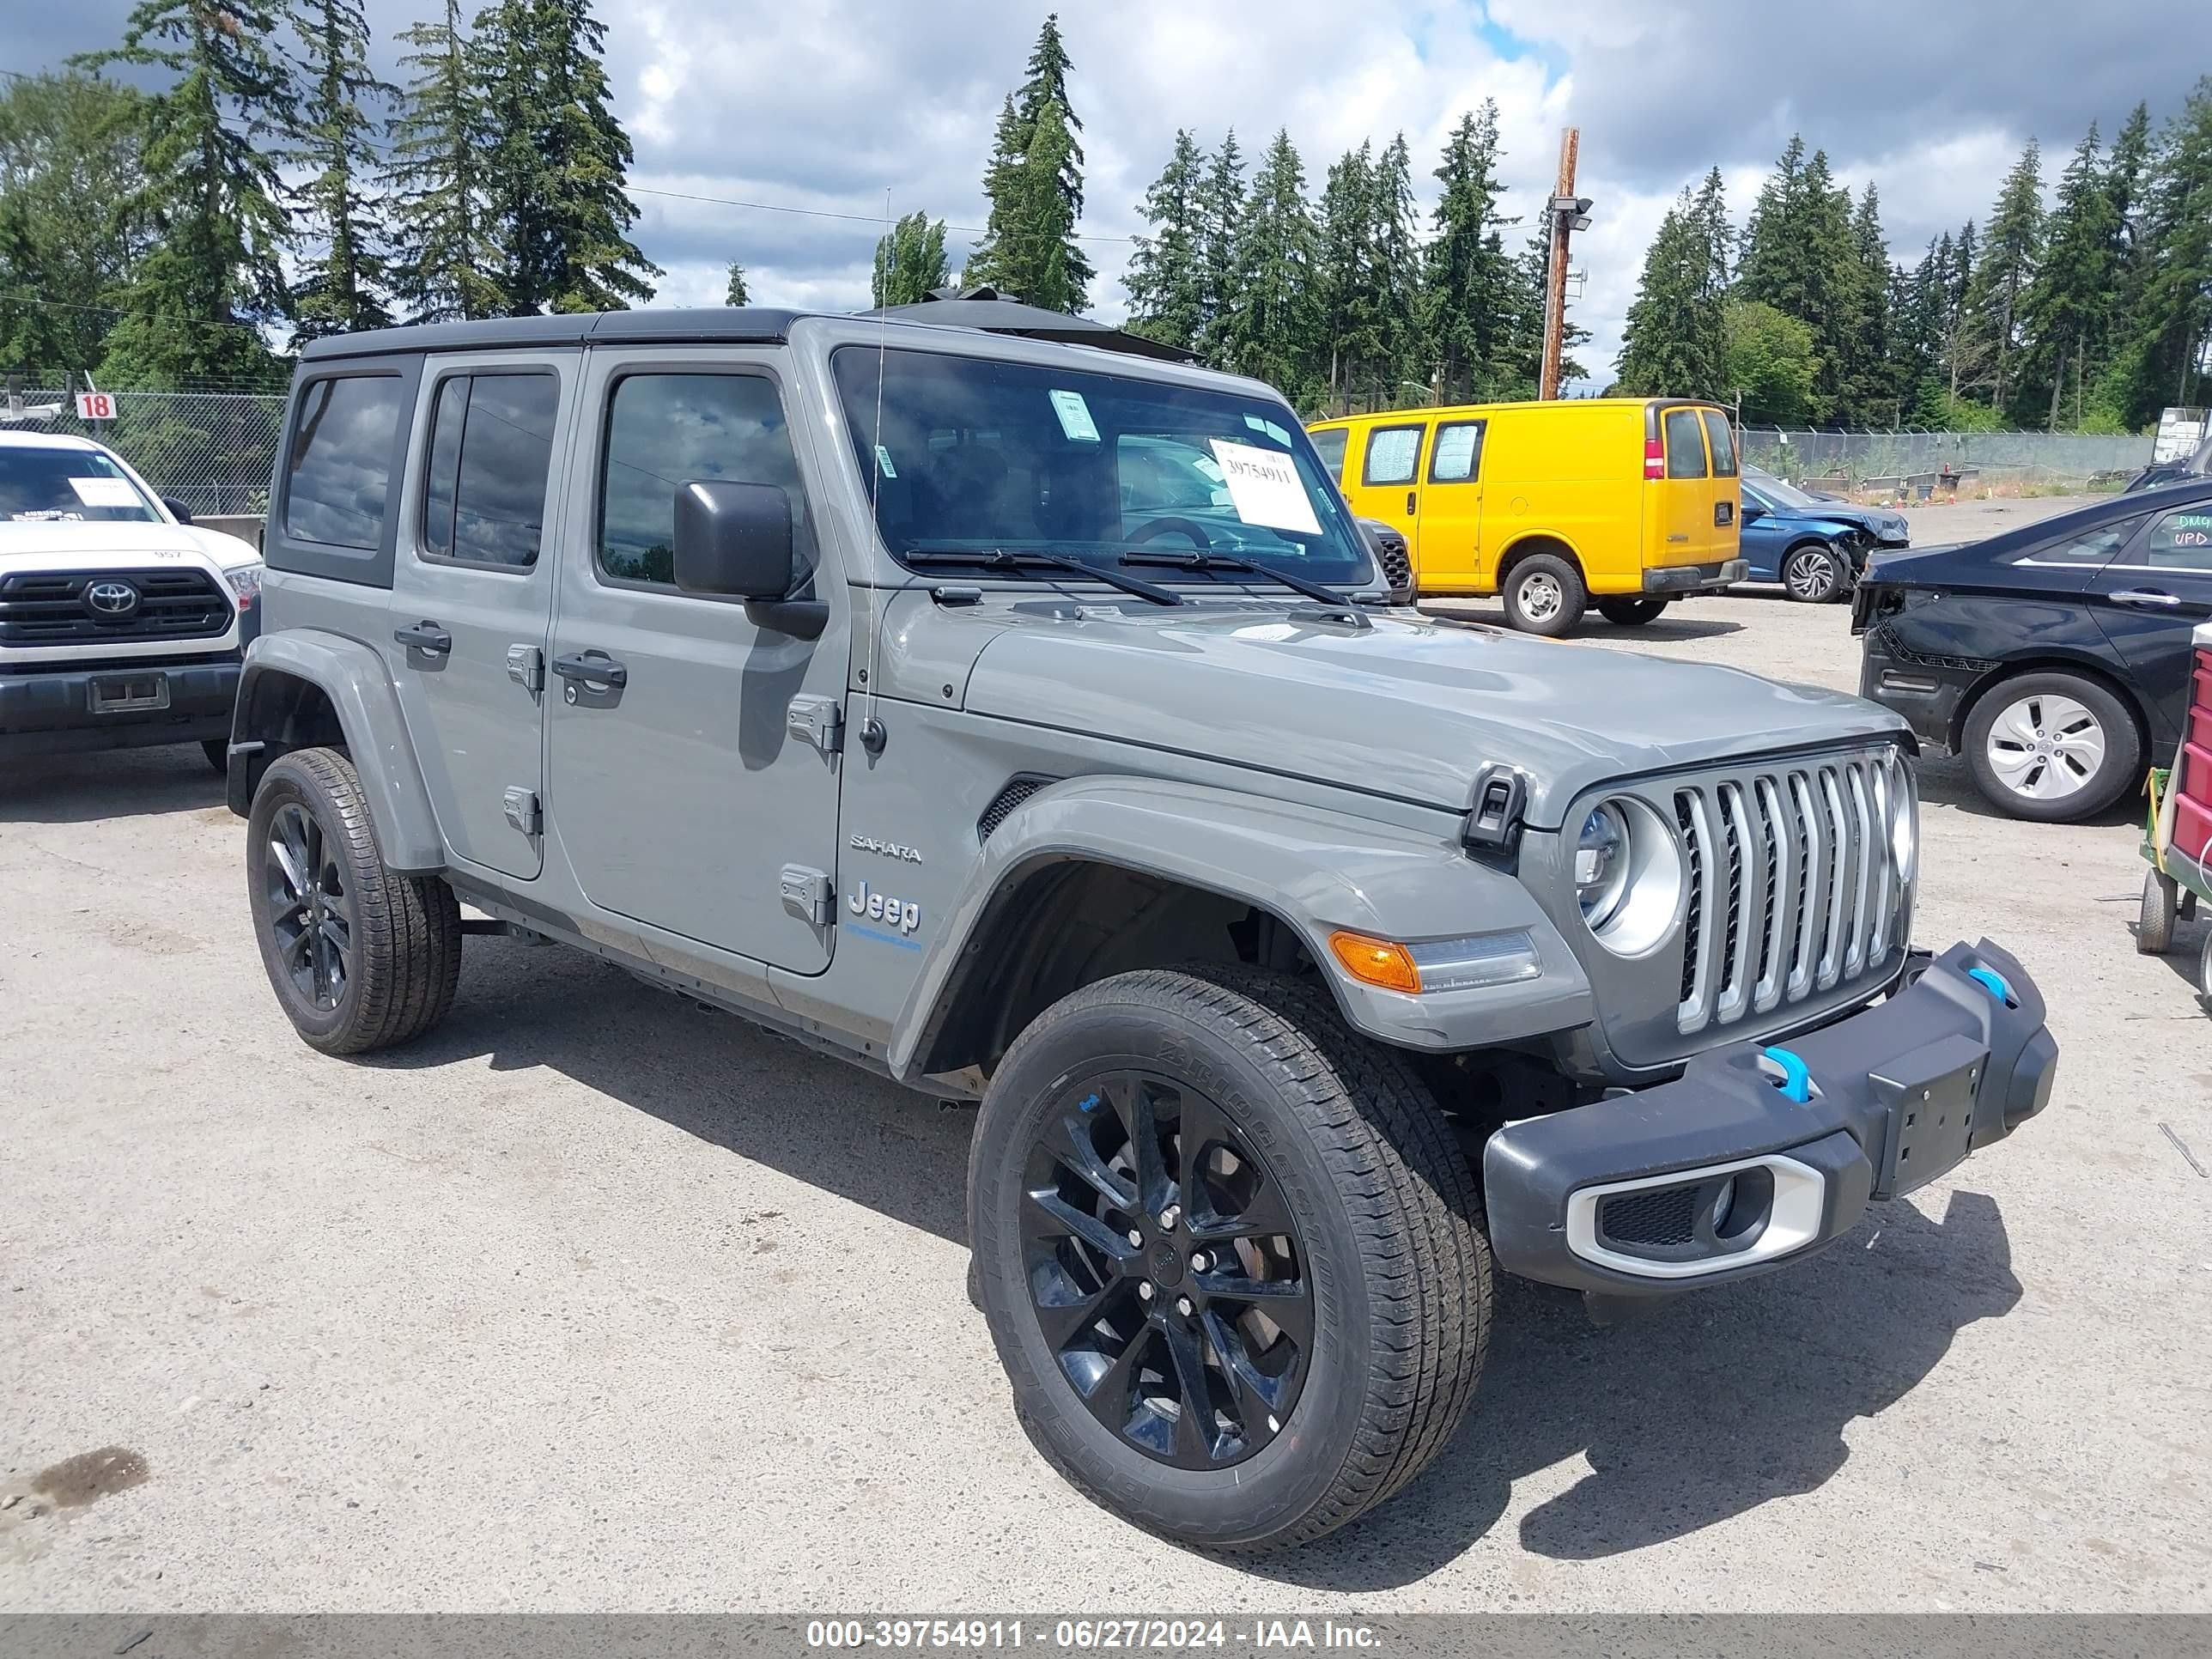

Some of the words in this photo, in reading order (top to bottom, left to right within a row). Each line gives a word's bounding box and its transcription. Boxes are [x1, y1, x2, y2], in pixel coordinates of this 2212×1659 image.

[82, 395, 109, 417] 18
[1226, 459, 1291, 484] 39754911
[850, 834, 923, 864] SAHARA
[847, 879, 921, 936] Jeep
[1157, 1038, 1340, 1365] BRIDGESTONE
